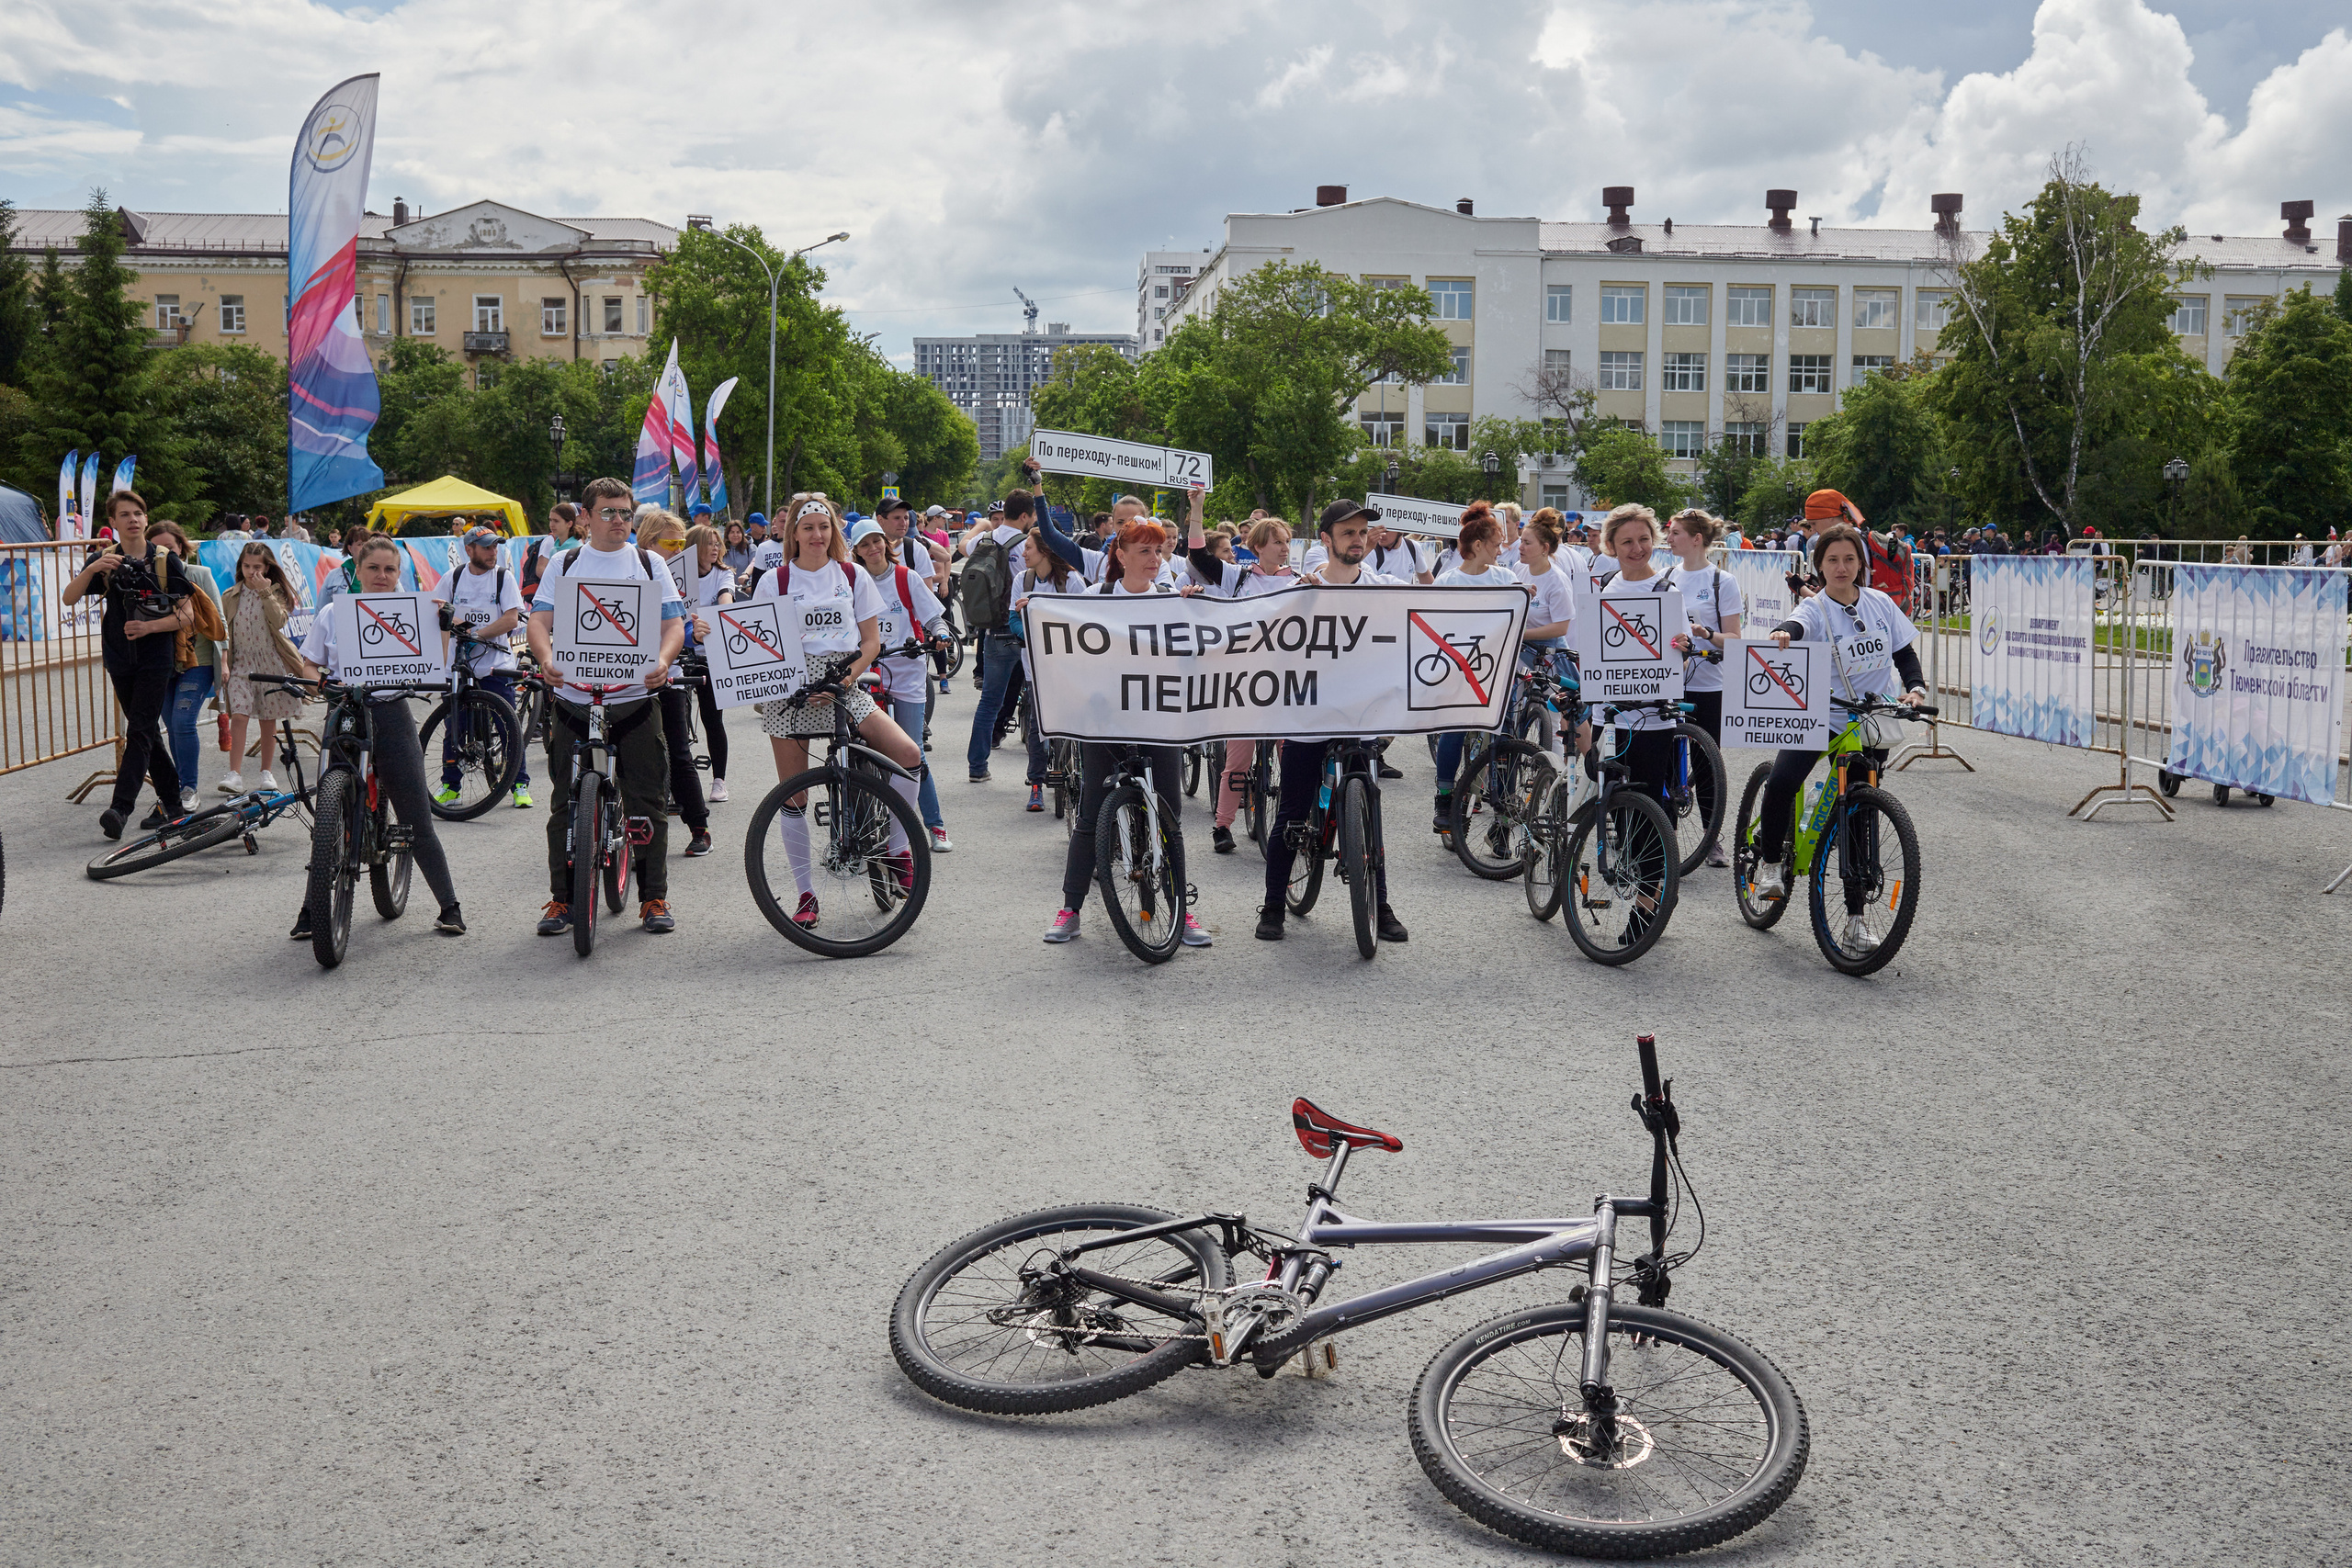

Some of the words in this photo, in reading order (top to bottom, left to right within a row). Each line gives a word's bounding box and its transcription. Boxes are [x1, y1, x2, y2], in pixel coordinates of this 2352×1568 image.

[1038, 441, 1053, 457] По
[1057, 446, 1162, 471] переходу-пешком!
[1174, 453, 1201, 478] 72
[1170, 475, 1189, 485] RUS
[464, 613, 491, 623] 0099
[805, 611, 842, 626] 0028
[877, 621, 893, 633] 13
[1042, 620, 1111, 656] ПО
[1848, 638, 1883, 658] 1006
[2244, 638, 2318, 670] Правительство
[556, 650, 575, 662] ПО
[344, 666, 362, 678] ПО
[575, 667, 635, 679] ПЕШКОМ
[1584, 669, 1602, 681] ПО
[716, 678, 733, 690] ПО
[1603, 682, 1660, 695] ПЕШКОМ
[2230, 668, 2286, 698] Тюменской
[736, 682, 789, 701] ПЕШКОМ
[1120, 670, 1318, 714] ПЕШКОМ
[1724, 716, 1744, 728] ПО
[1745, 731, 1804, 745] ПЕШКОМ
[1475, 1318, 1532, 1346] KENDATIRE.COM
